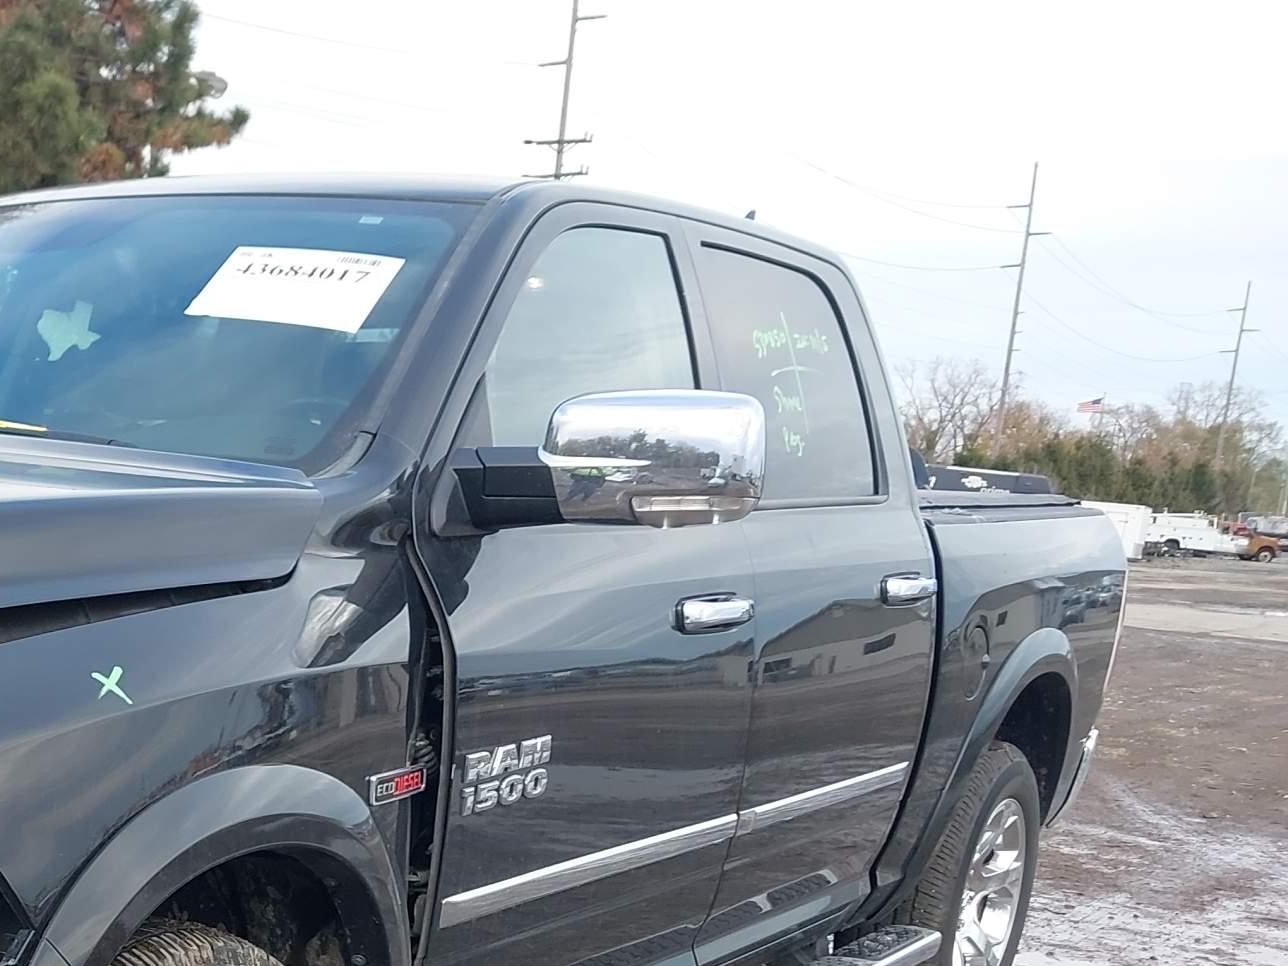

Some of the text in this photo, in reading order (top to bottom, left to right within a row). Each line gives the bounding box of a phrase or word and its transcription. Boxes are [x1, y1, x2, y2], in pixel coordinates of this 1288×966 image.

[236, 261, 371, 283] 43684017
[464, 734, 552, 784] RAM
[462, 767, 549, 817] 1500
